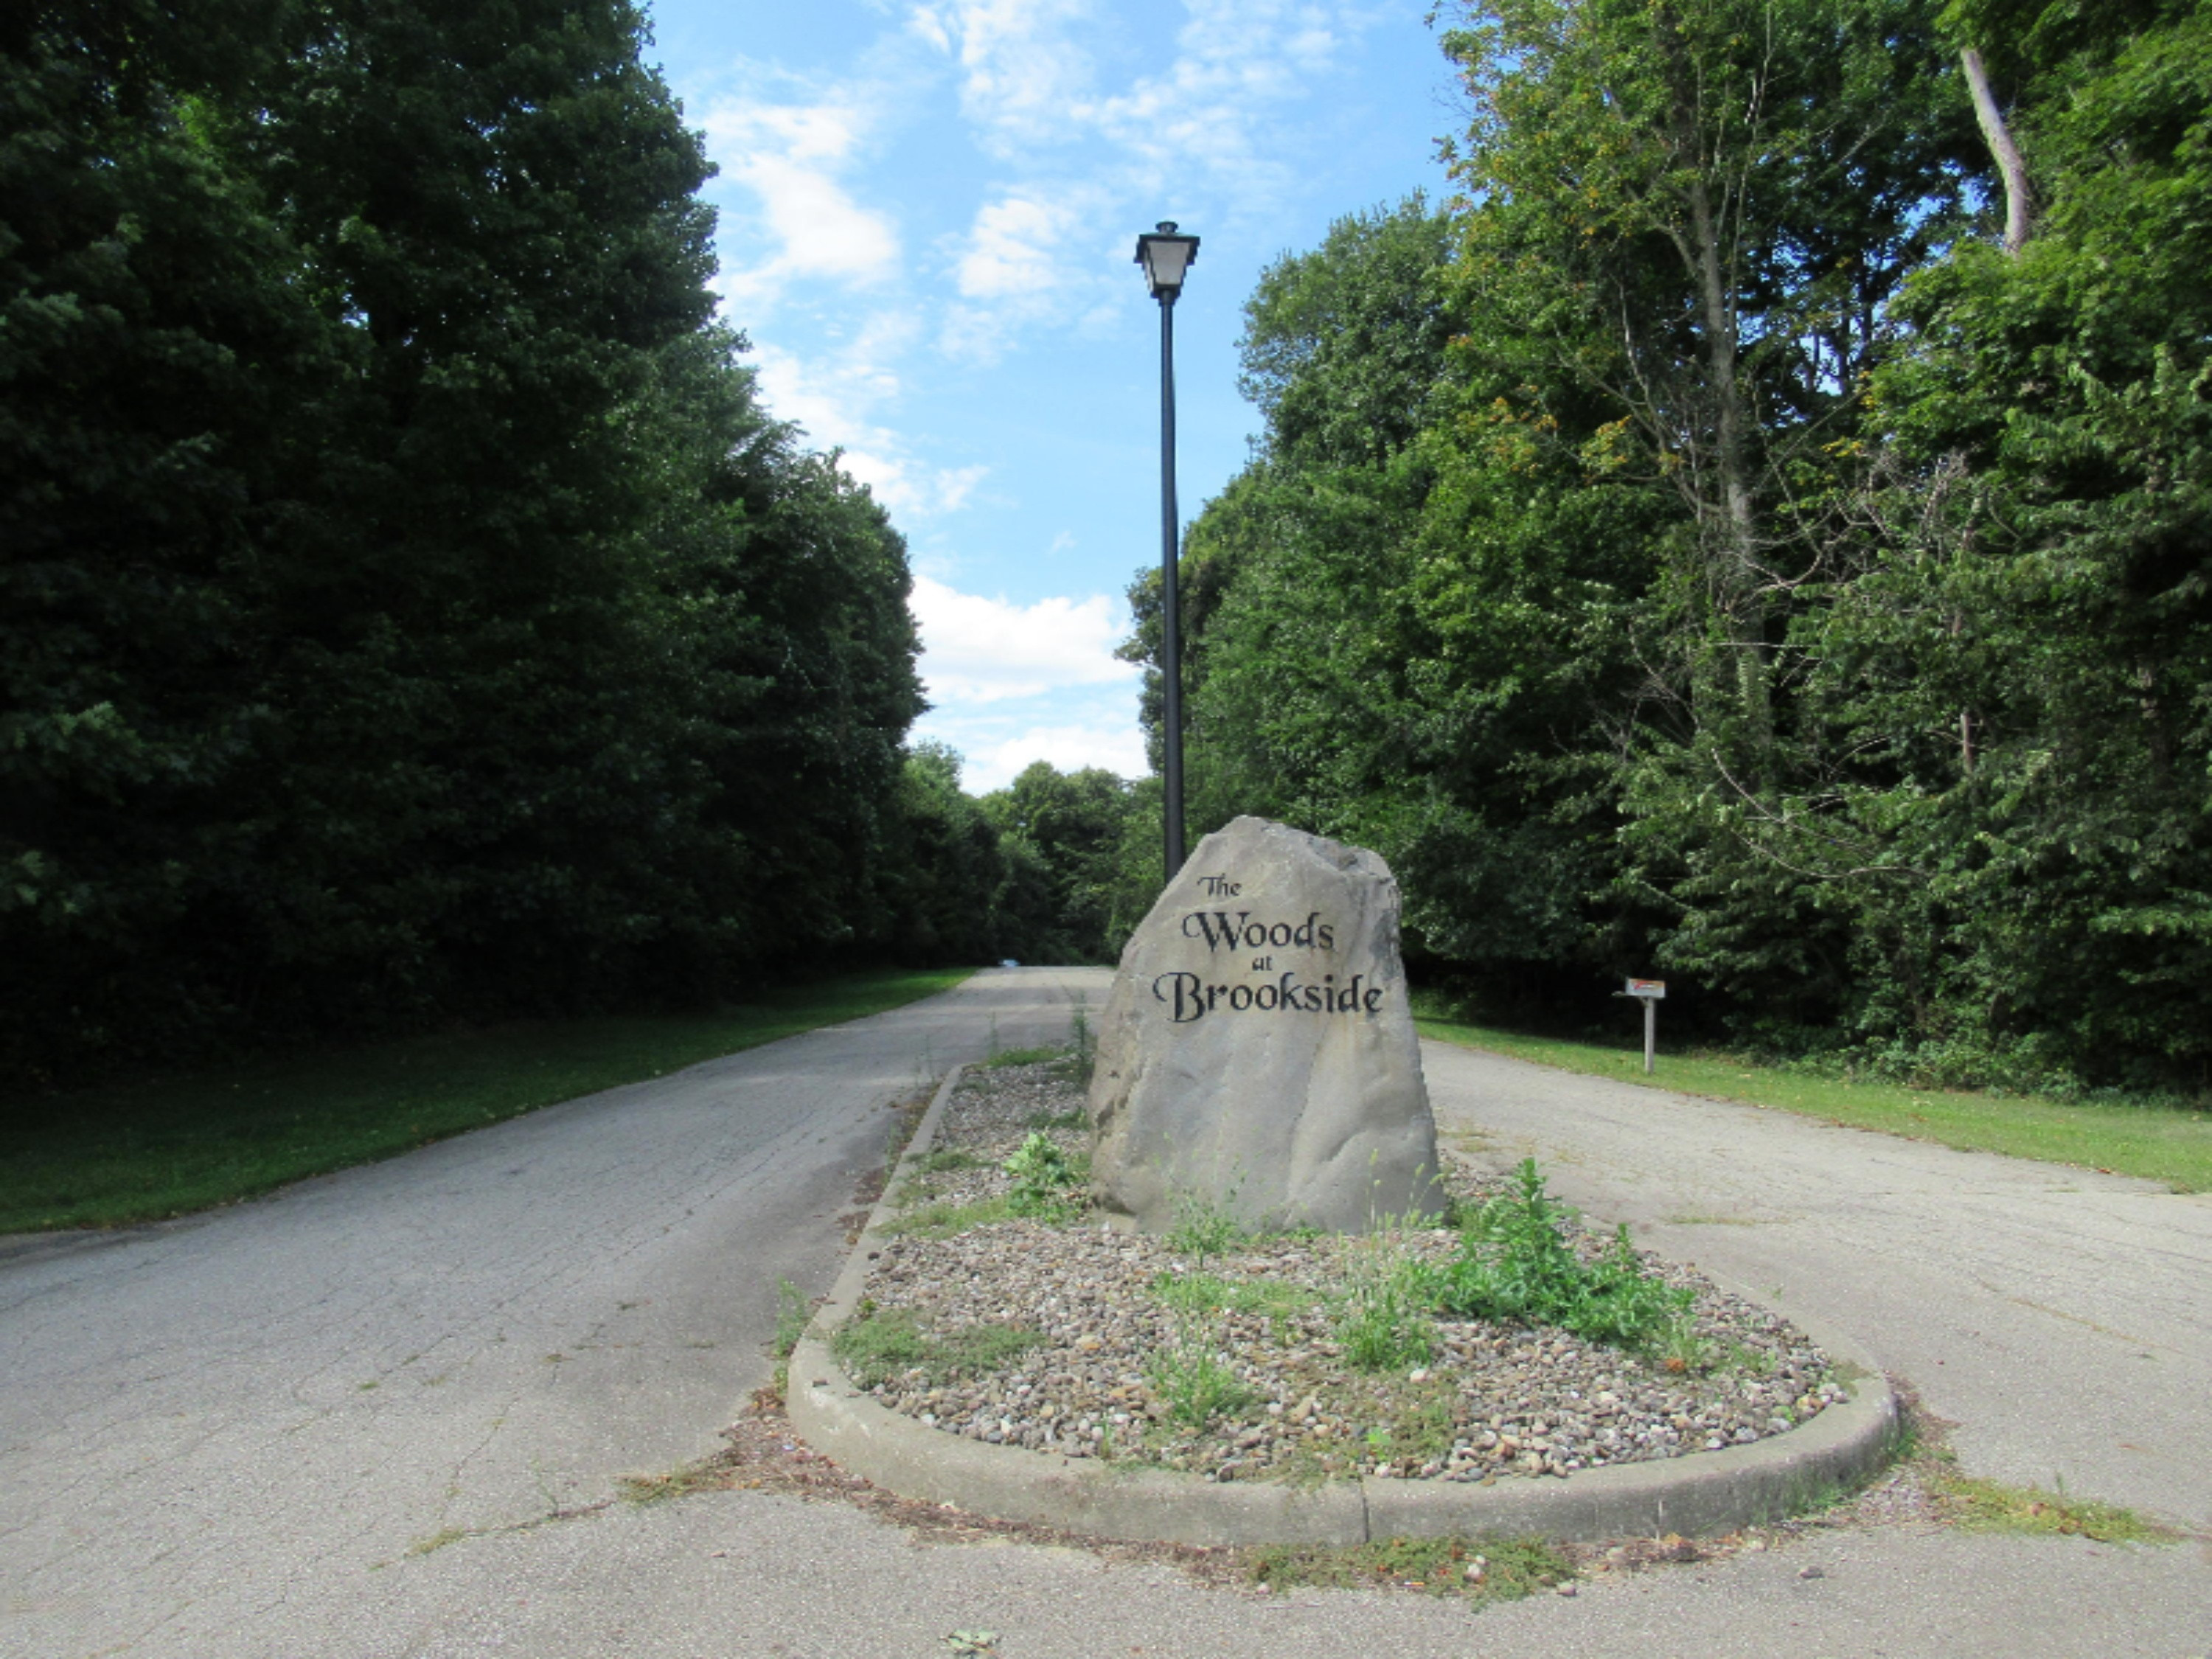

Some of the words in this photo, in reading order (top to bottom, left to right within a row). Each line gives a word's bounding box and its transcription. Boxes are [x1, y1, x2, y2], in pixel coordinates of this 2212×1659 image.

[1197, 873, 1242, 897] The
[1182, 912, 1335, 952] Woods
[1252, 956, 1273, 971] at
[1152, 972, 1383, 1023] Brookside
